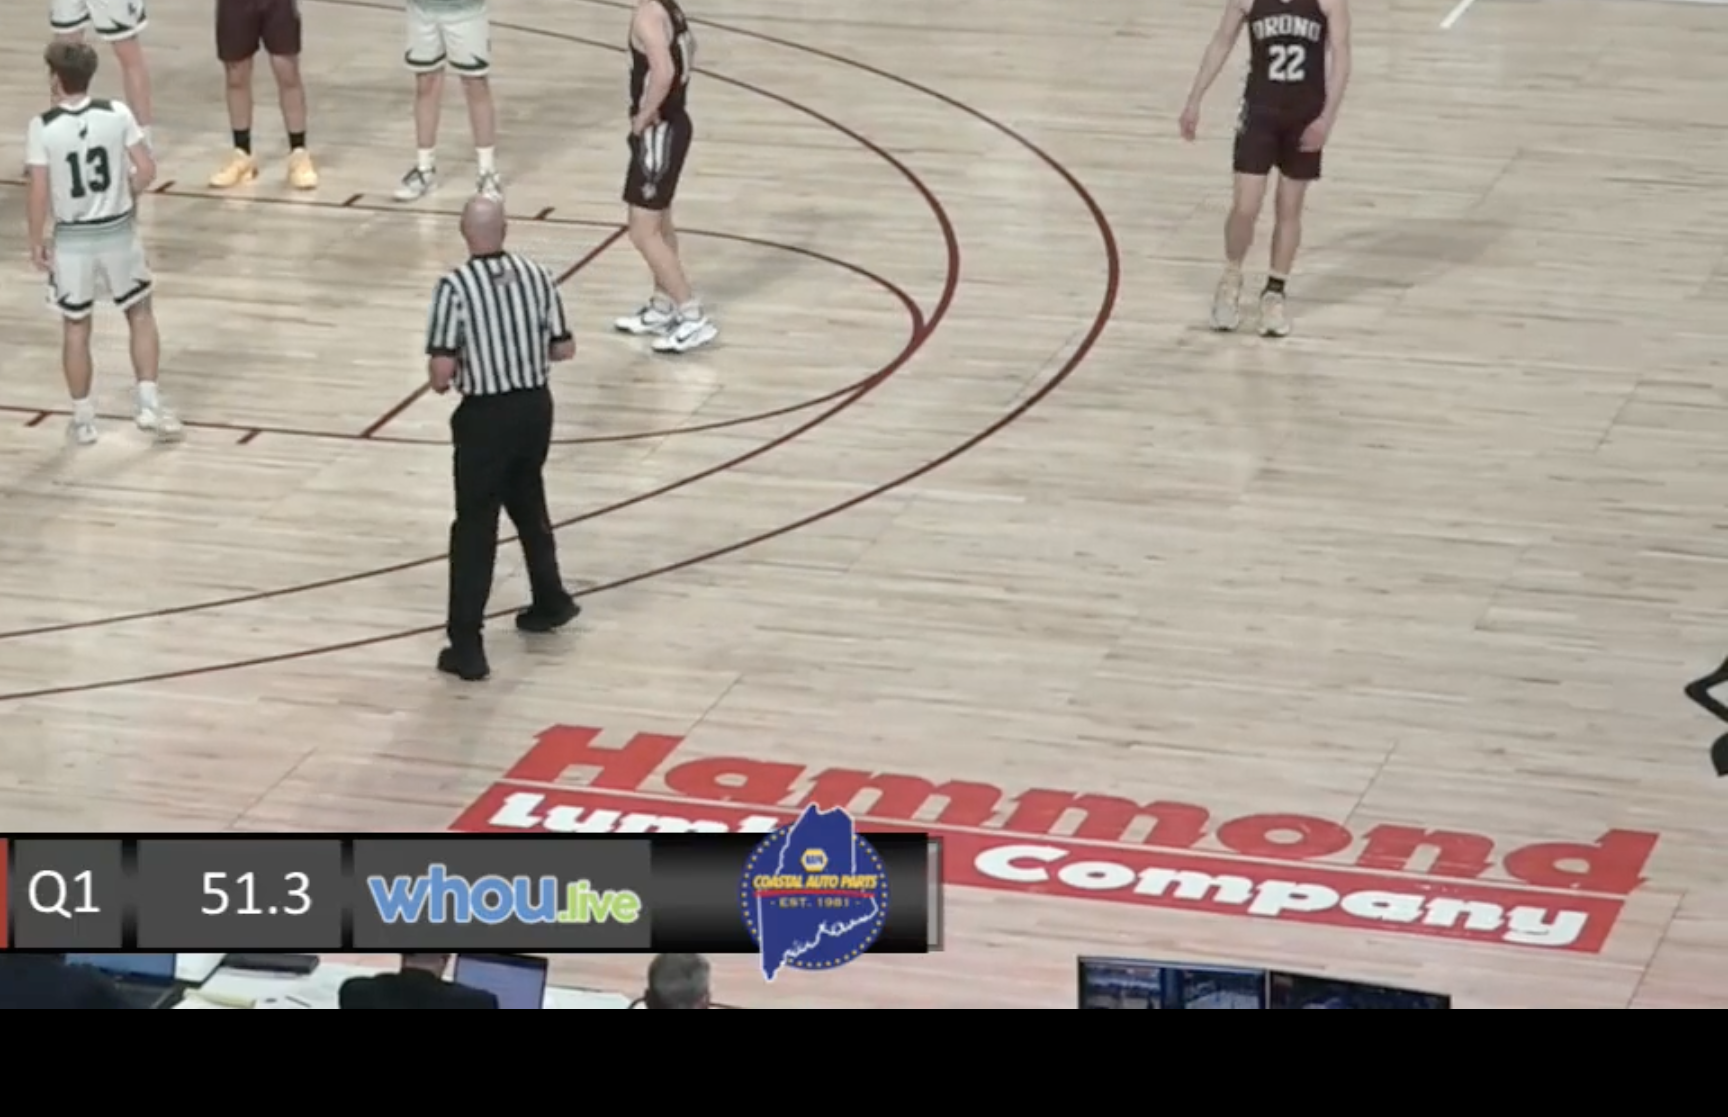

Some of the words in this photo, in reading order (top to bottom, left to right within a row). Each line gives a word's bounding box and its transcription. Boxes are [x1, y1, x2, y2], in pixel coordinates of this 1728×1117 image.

[1252, 14, 1322, 43] ORONO
[1268, 44, 1306, 82] 22
[65, 146, 110, 199] 13
[505, 724, 1660, 896] Hammond
[974, 845, 1588, 946] Company
